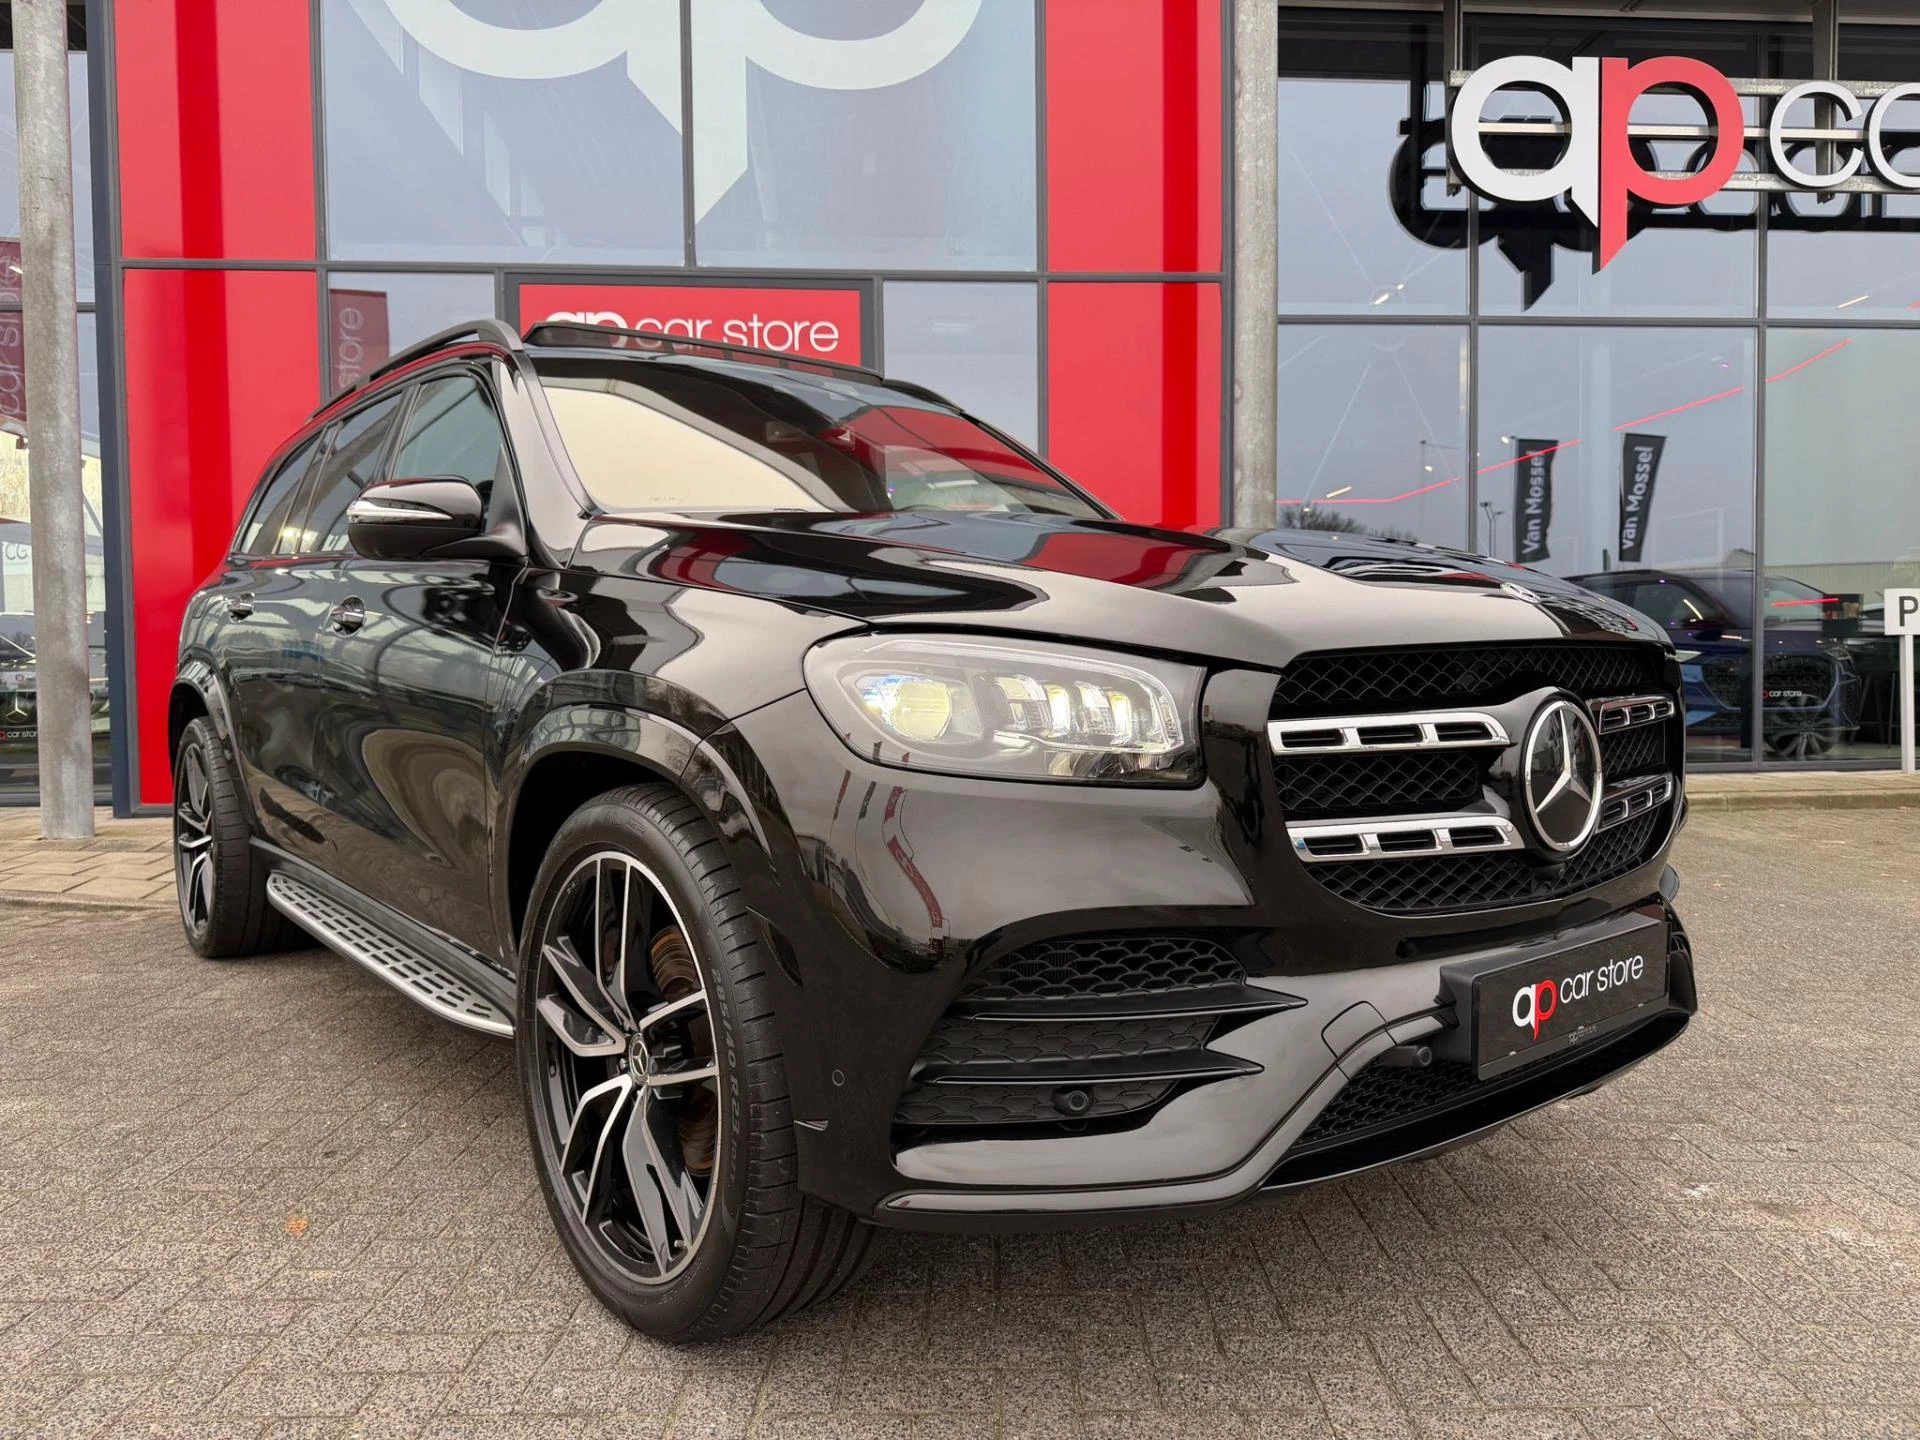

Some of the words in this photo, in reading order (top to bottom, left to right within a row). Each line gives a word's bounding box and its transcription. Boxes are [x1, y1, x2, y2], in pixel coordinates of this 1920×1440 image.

[723, 313, 839, 352] store
[1524, 450, 1546, 515] Mossel
[1625, 445, 1653, 512] Mossel
[1522, 517, 1543, 554] Van
[21, 730, 38, 738] stor
[1560, 970, 1594, 1004] car
[1597, 955, 1644, 992] store
